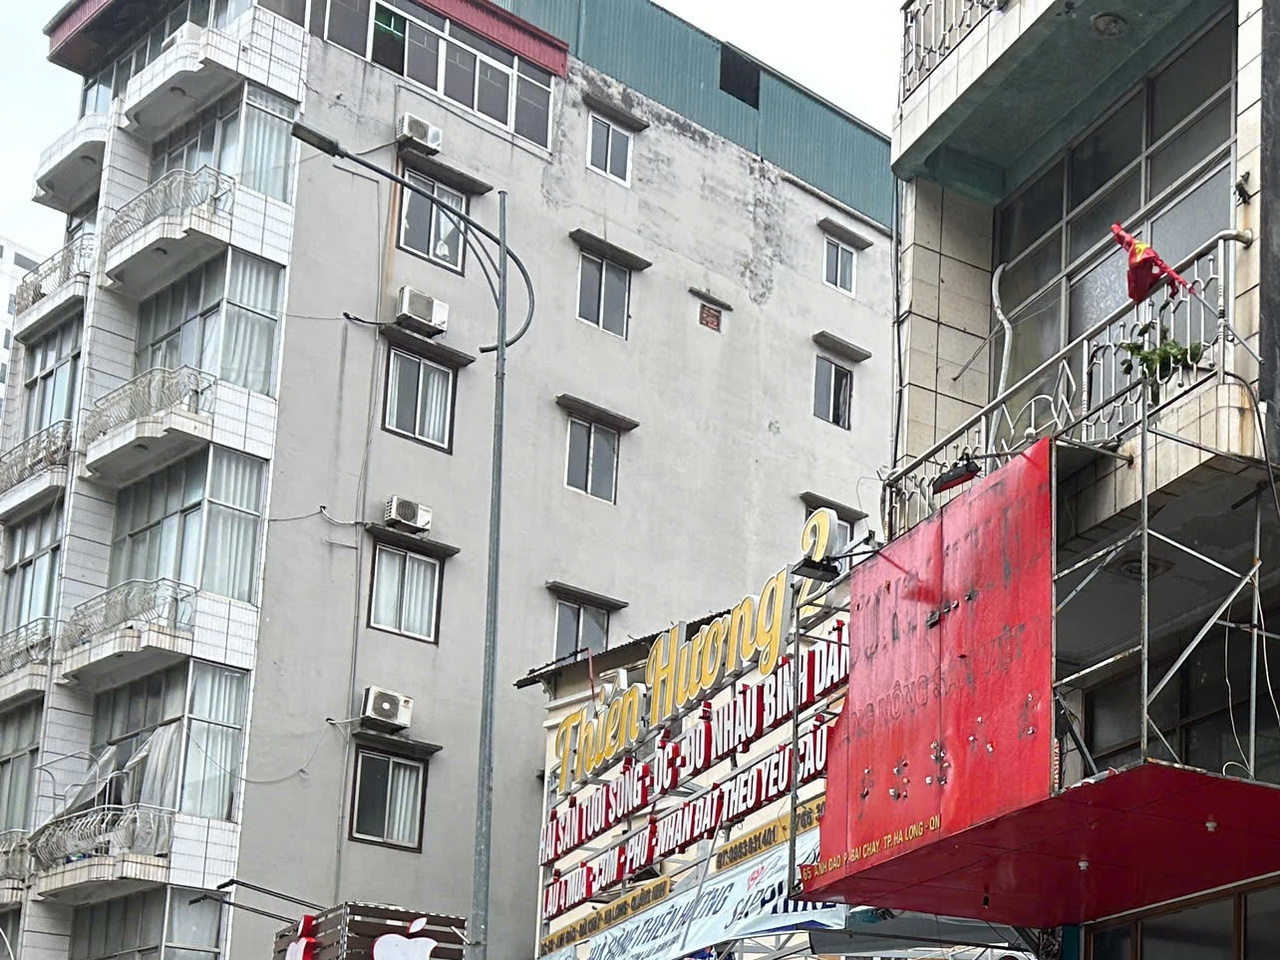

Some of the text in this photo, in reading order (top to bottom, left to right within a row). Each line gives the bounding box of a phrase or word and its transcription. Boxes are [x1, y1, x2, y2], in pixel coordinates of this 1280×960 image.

[555, 670, 643, 795] Thiên
[645, 567, 788, 729] Hương
[905, 821, 924, 840] LONG
